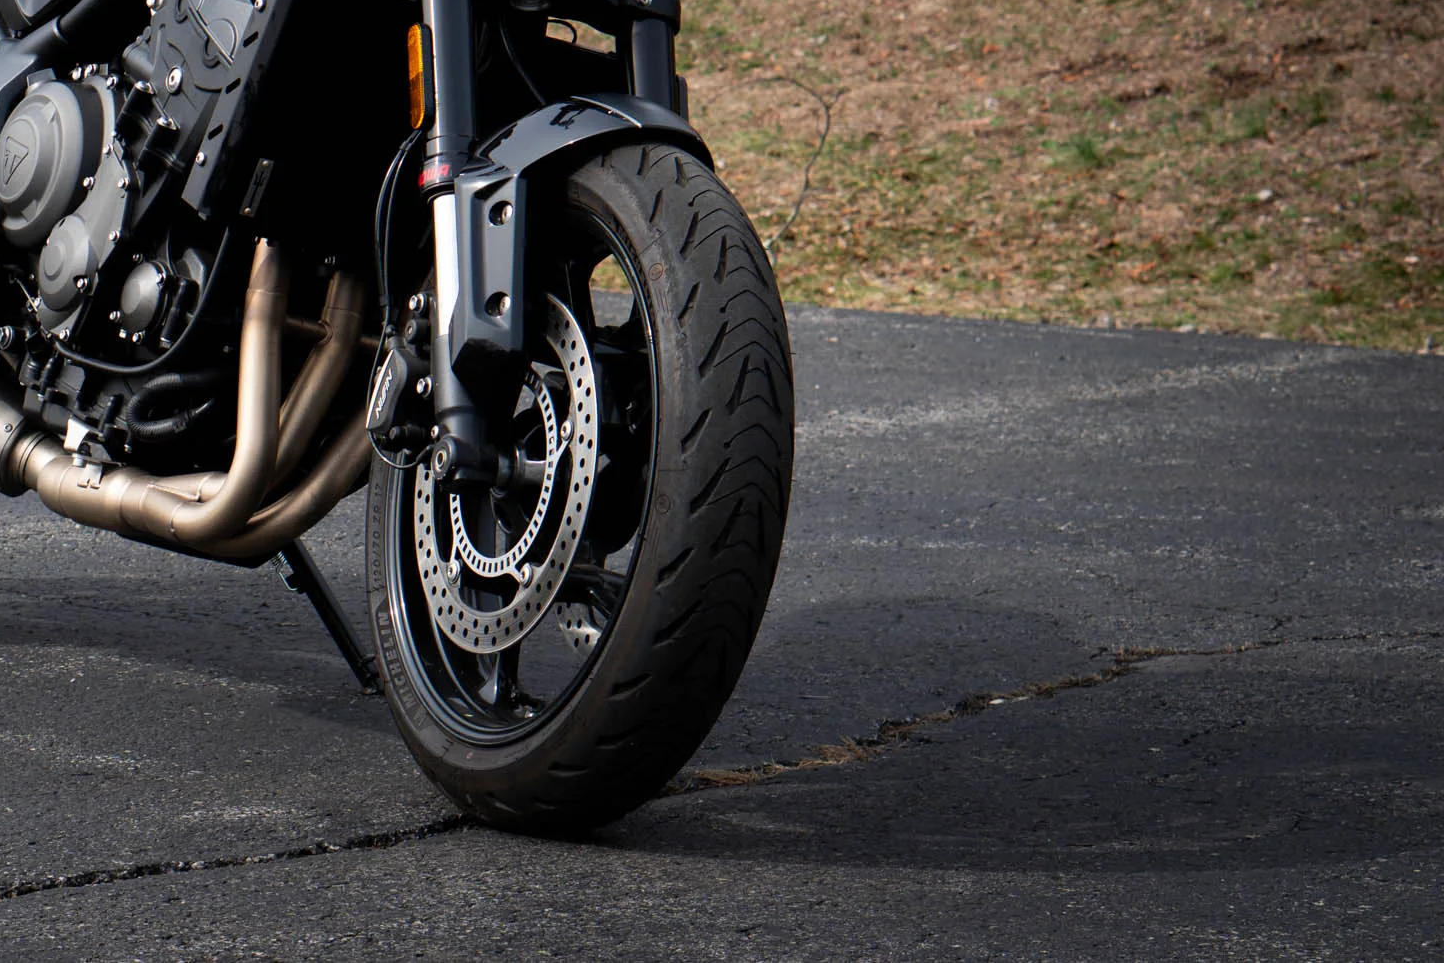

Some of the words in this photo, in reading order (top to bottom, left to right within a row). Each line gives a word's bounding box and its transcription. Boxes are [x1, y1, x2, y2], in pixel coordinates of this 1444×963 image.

[373, 481, 383, 497] 17
[372, 504, 382, 525] ZR
[372, 529, 382, 583] 120/70
[376, 611, 417, 711] MICHELIN
